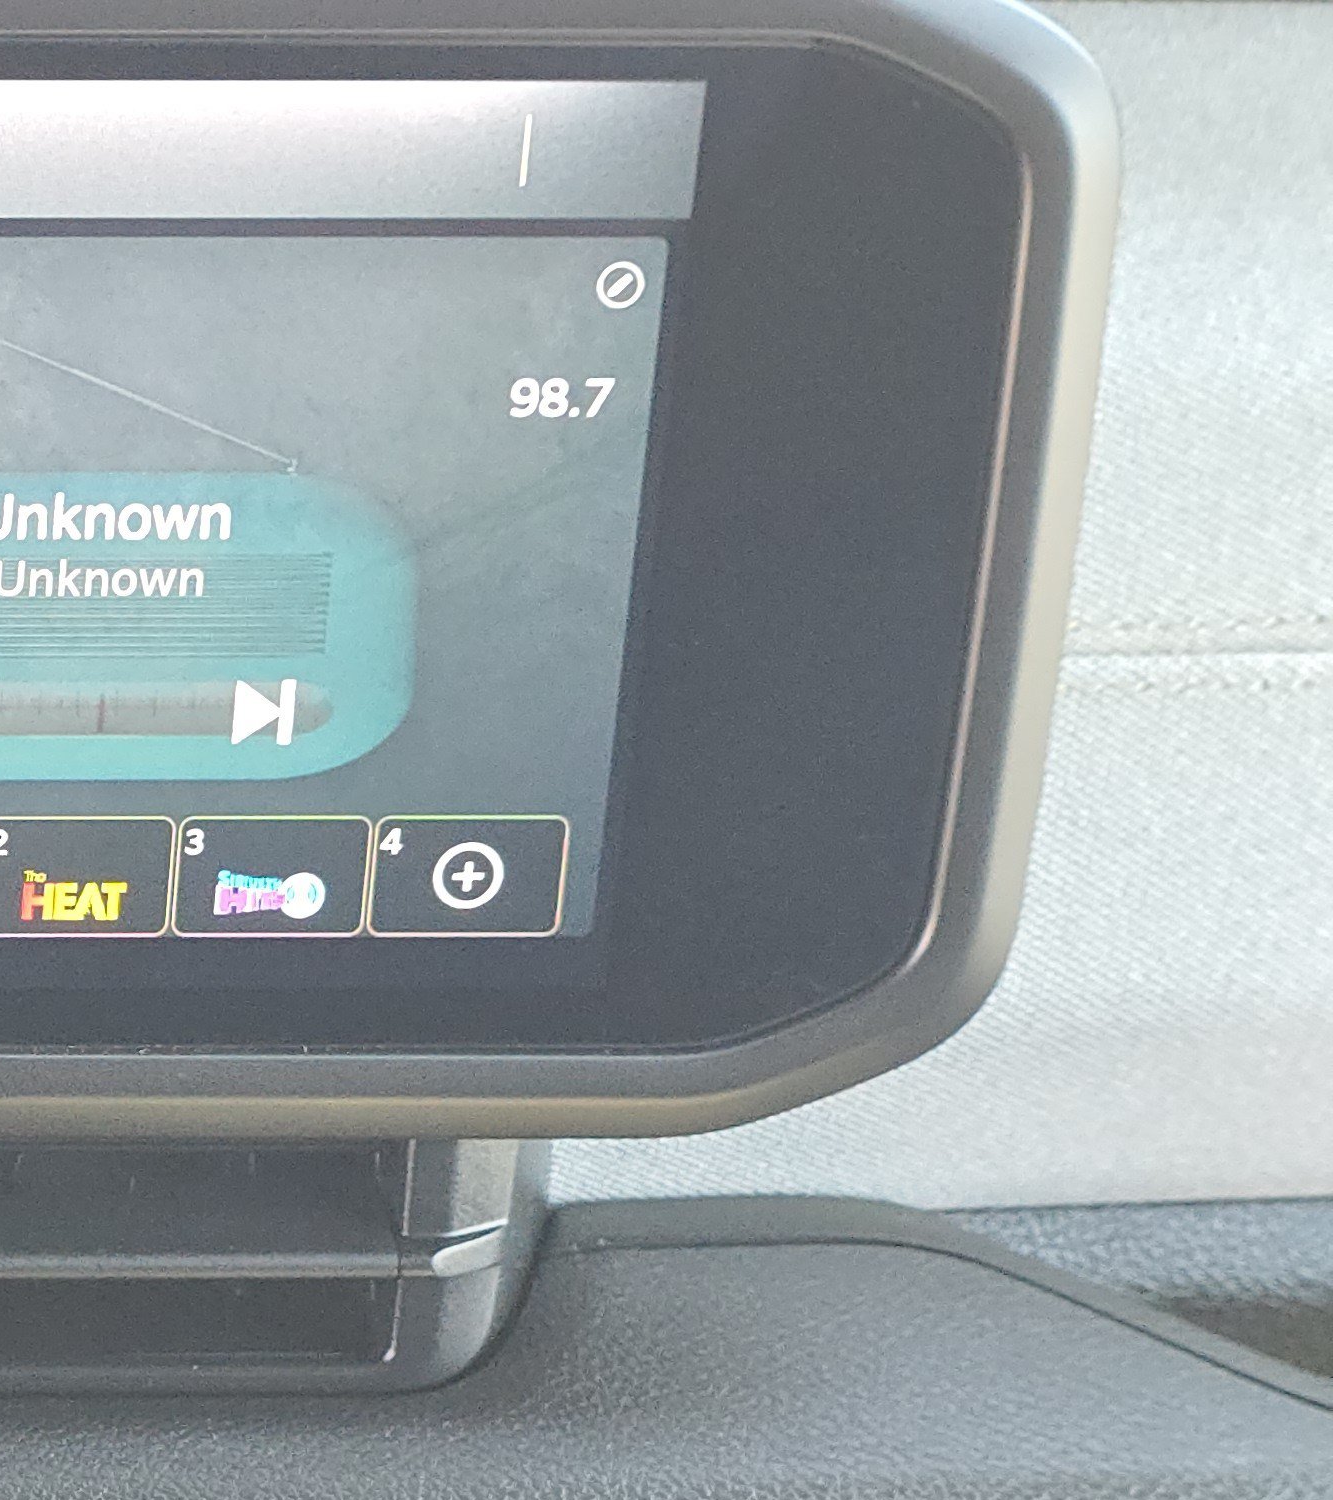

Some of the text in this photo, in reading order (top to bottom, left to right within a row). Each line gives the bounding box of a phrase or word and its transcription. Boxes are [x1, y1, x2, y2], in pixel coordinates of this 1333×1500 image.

[507, 376, 617, 420] 98.7
[184, 828, 205, 856] 3
[378, 828, 405, 856] 4
[20, 882, 128, 921] HEAT
